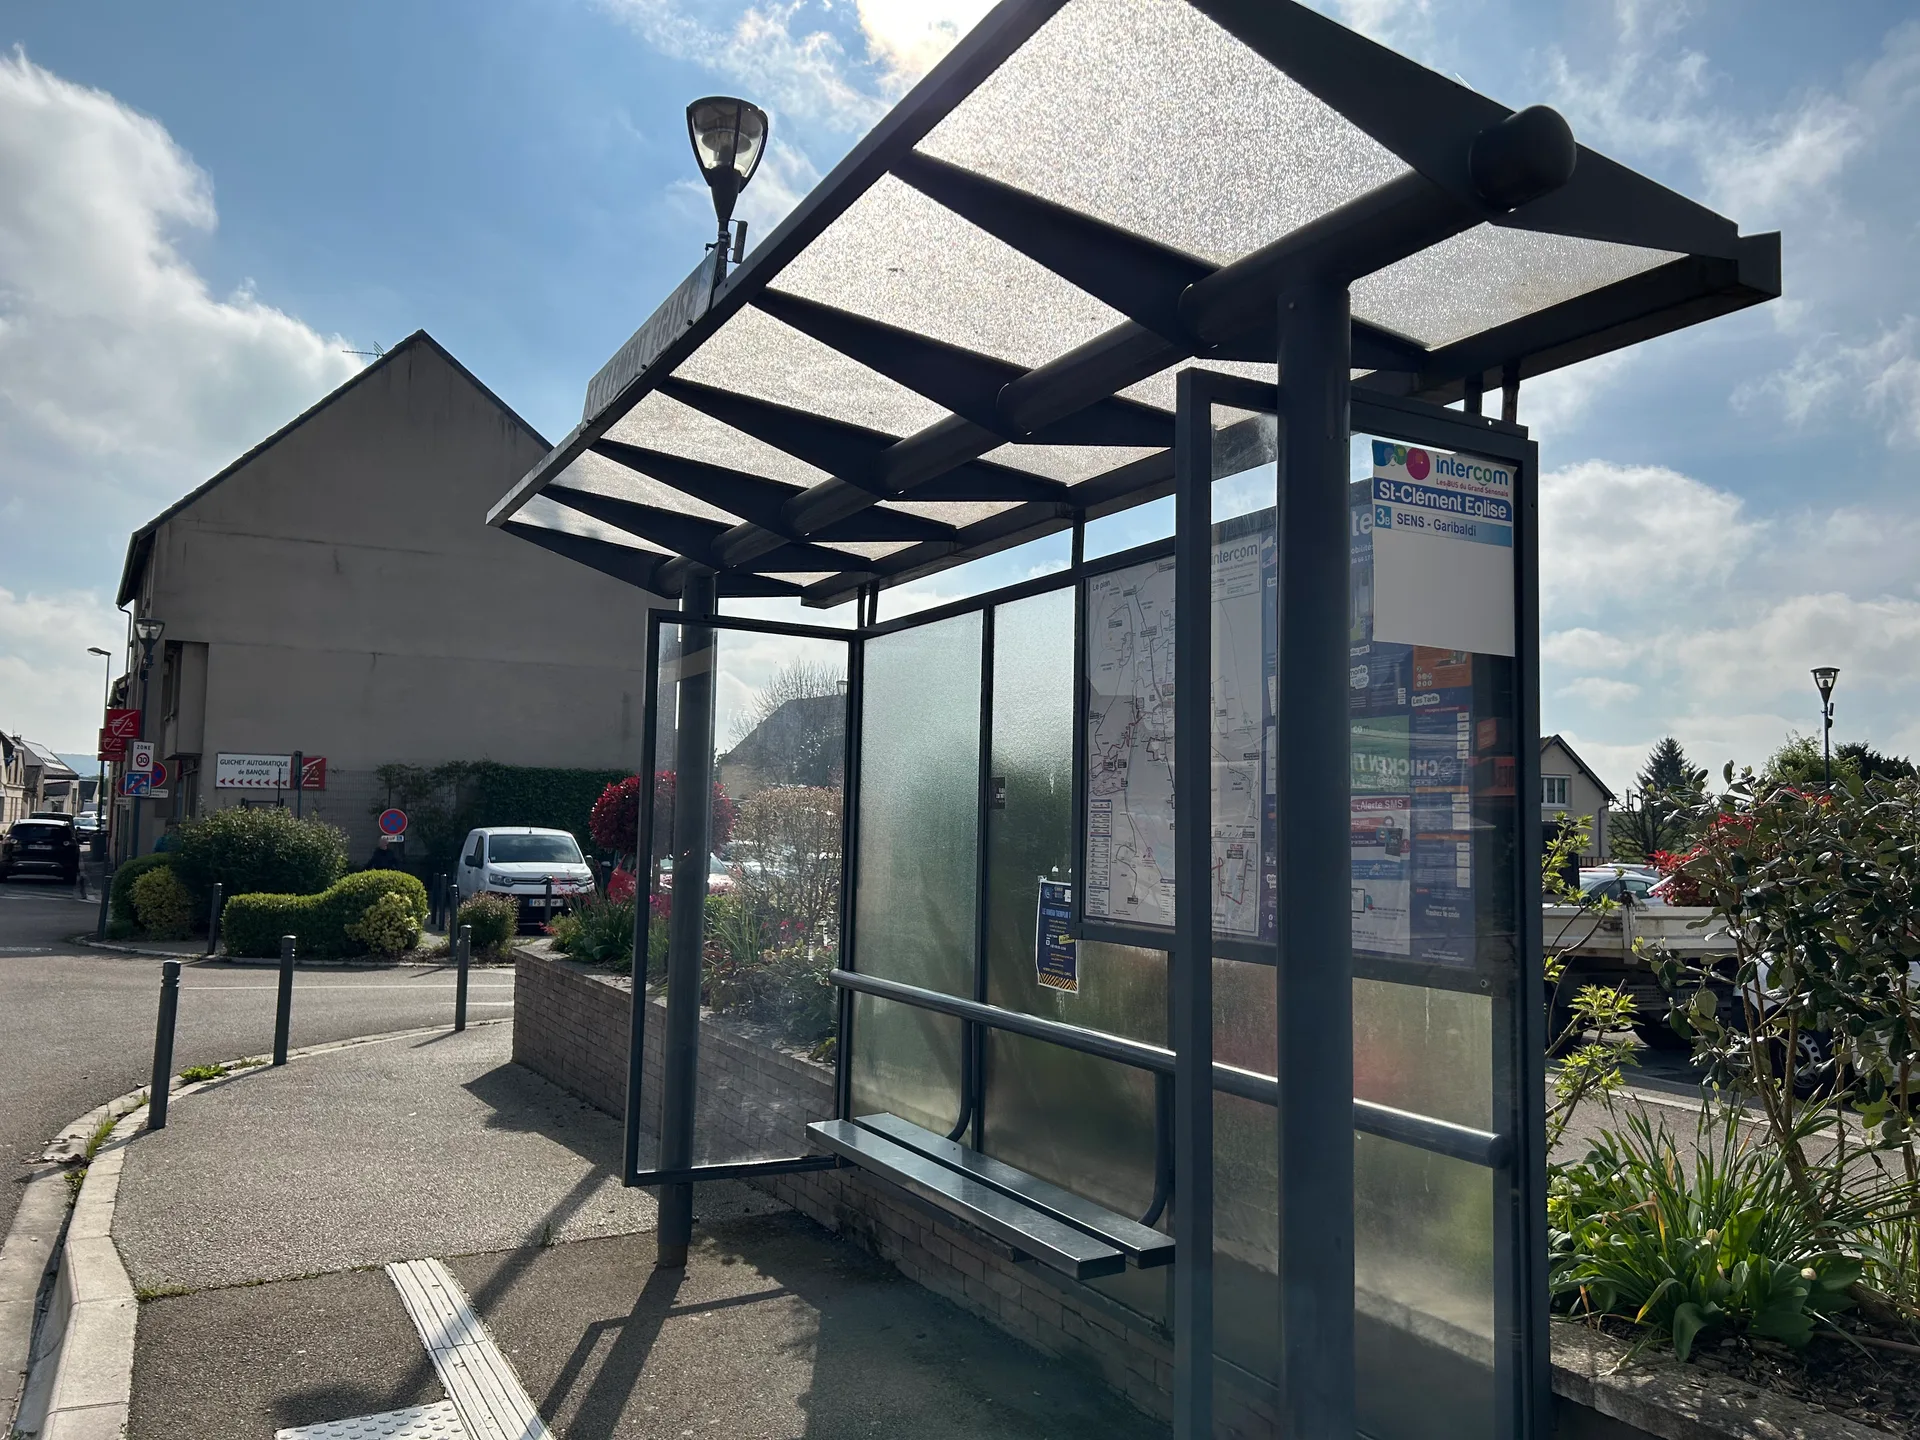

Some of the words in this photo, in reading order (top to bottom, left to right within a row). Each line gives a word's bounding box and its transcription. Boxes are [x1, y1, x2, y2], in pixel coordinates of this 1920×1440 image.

[1436, 455, 1508, 486] intercom
[1436, 478, 1447, 486] Les
[1468, 484, 1484, 494] Grand
[1379, 480, 1462, 512] St-Clément
[1465, 499, 1507, 519] Eglise
[1396, 513, 1425, 528] SENS
[1434, 519, 1477, 537] Garibaldi
[1211, 544, 1258, 565] intercom
[1092, 583, 1098, 592] Le
[1099, 580, 1111, 591] plan
[1413, 696, 1423, 704] Les
[1424, 695, 1438, 704] Tarifs
[1385, 800, 1403, 808] SMS
